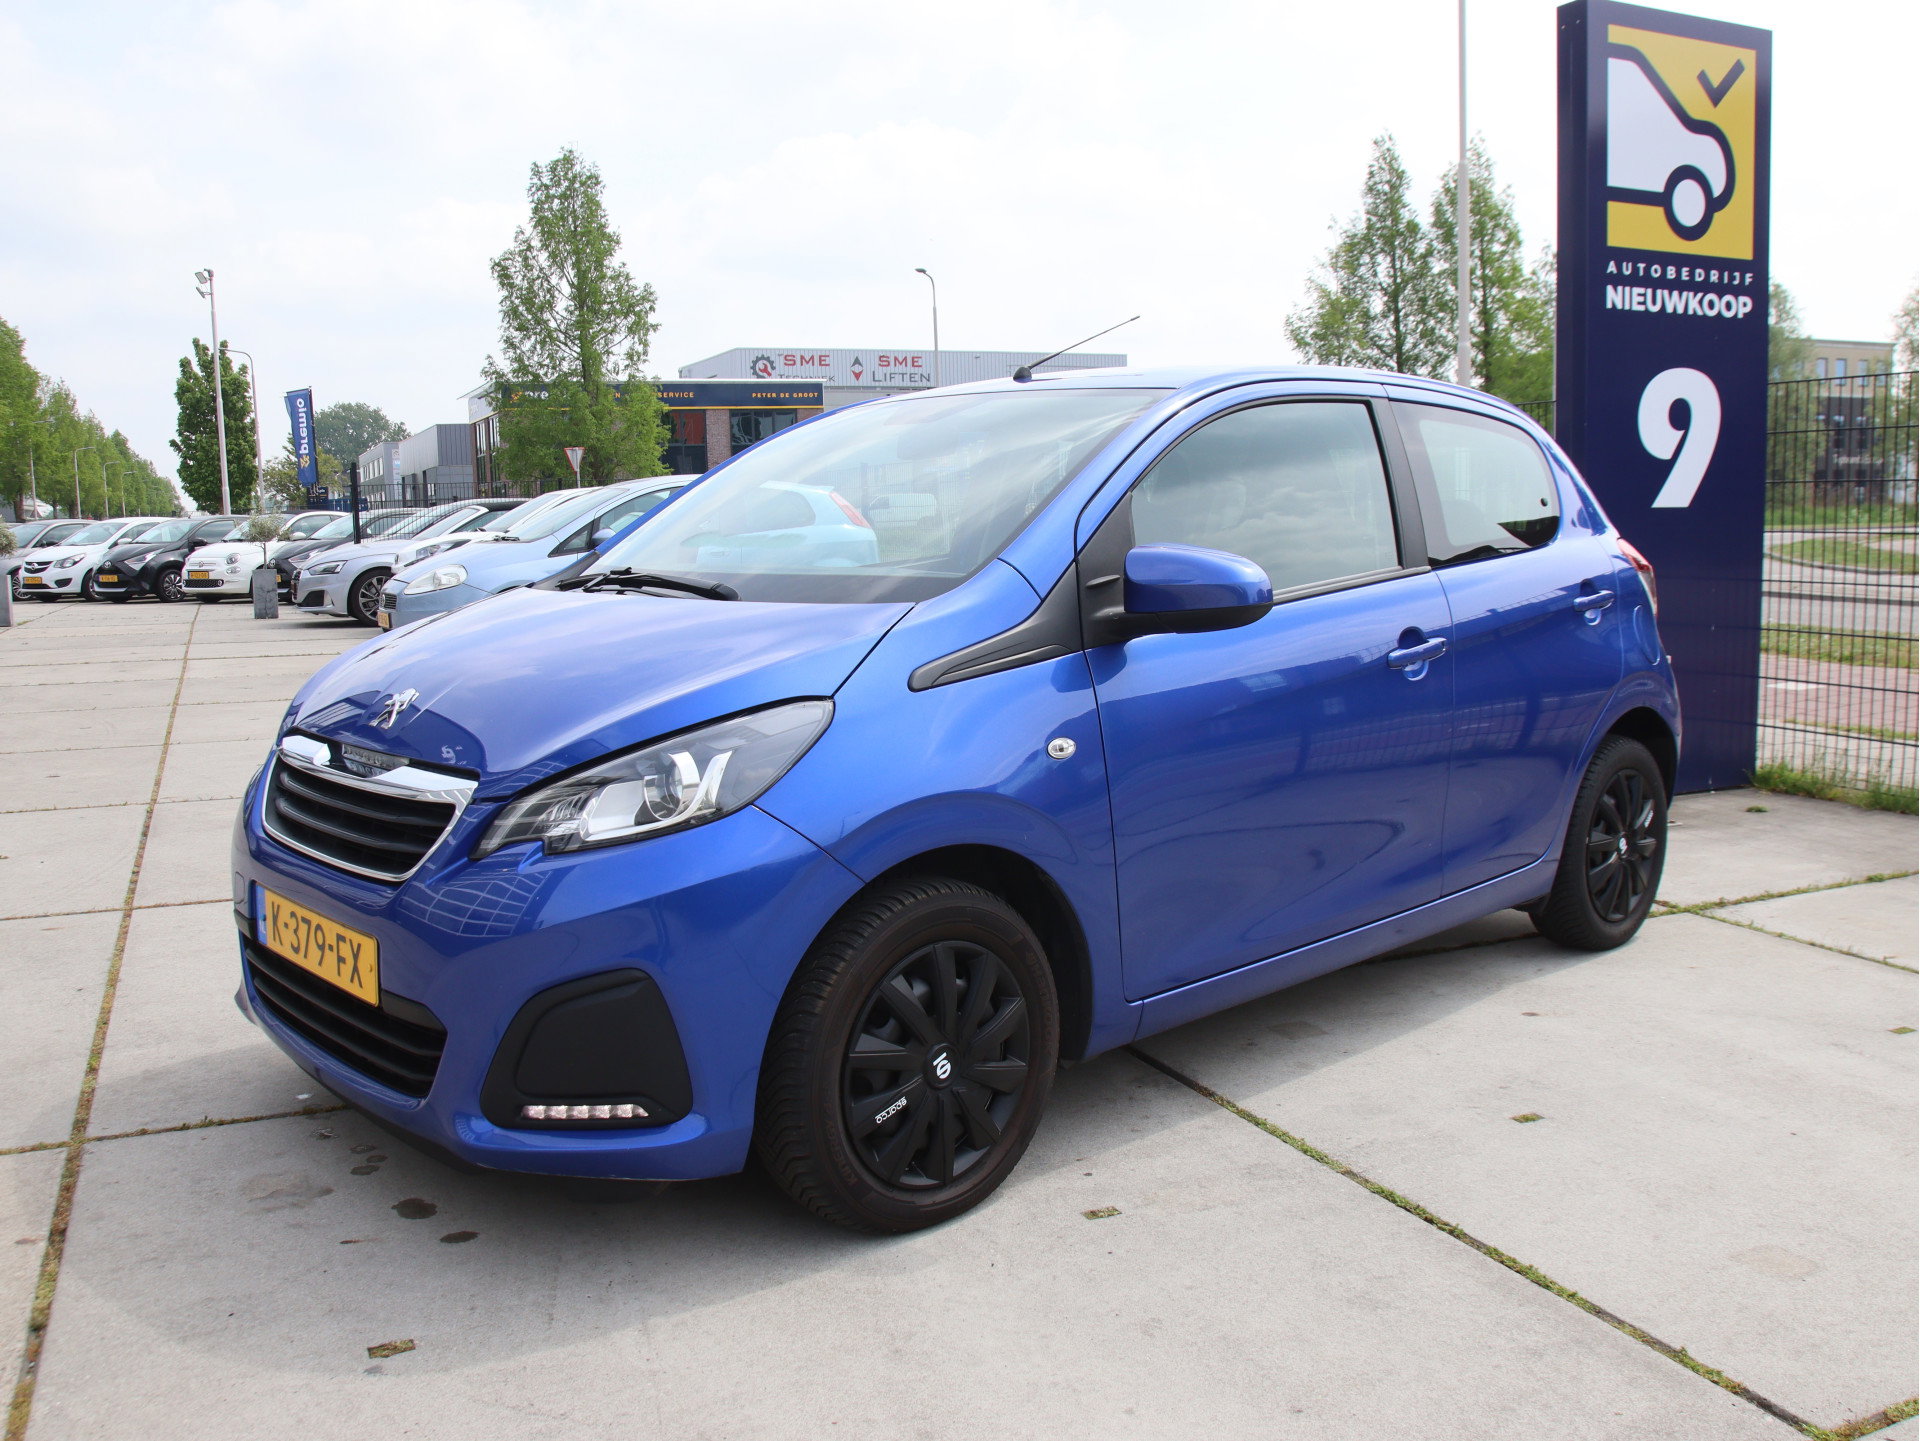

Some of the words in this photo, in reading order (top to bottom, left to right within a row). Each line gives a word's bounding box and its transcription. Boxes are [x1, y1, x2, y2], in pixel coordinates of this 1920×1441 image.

[1606, 260, 1753, 286] AUTOBEDRIJF
[1605, 285, 1753, 318] NIEUWKOOP
[784, 354, 830, 367] SME
[879, 355, 922, 367] SME
[872, 371, 930, 382] LIFTEN
[1637, 367, 1721, 508] 9
[271, 901, 363, 988] K-379-FX
[875, 1096, 907, 1124] sparco
